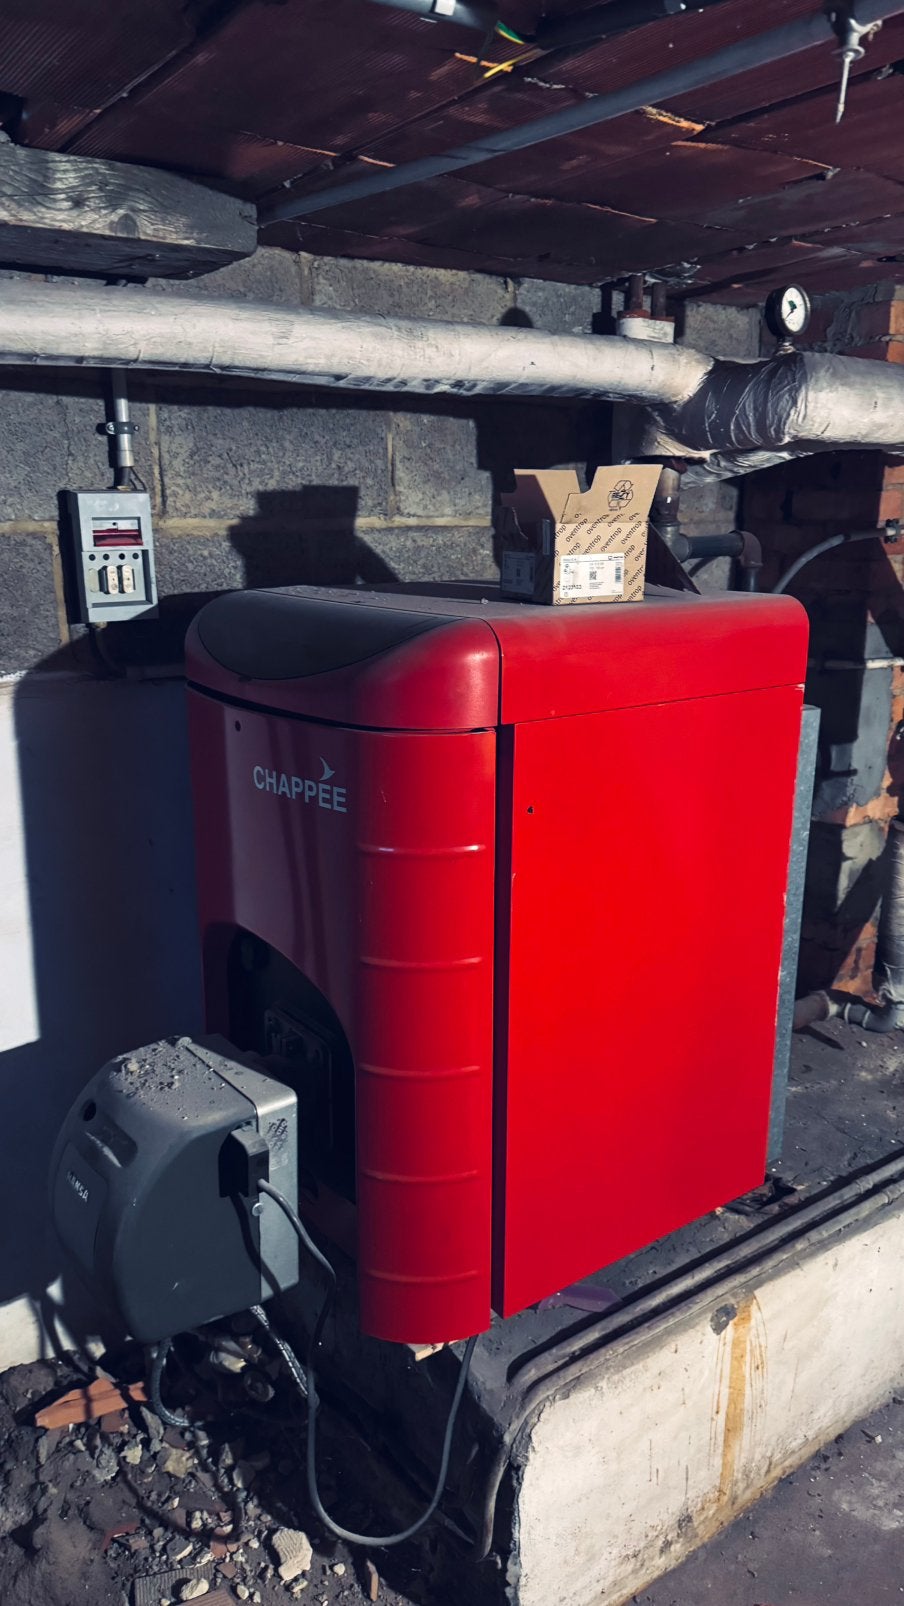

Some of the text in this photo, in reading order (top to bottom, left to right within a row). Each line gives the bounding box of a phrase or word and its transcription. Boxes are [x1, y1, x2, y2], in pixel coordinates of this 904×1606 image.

[555, 524, 567, 540] trop
[565, 518, 588, 543] oventrop
[600, 527, 623, 552] oventrop
[621, 520, 642, 545] oventrop
[567, 542, 581, 555] trop
[624, 544, 636, 559] trop
[628, 564, 644, 586] oventr
[253, 765, 347, 813] CHAPPEE
